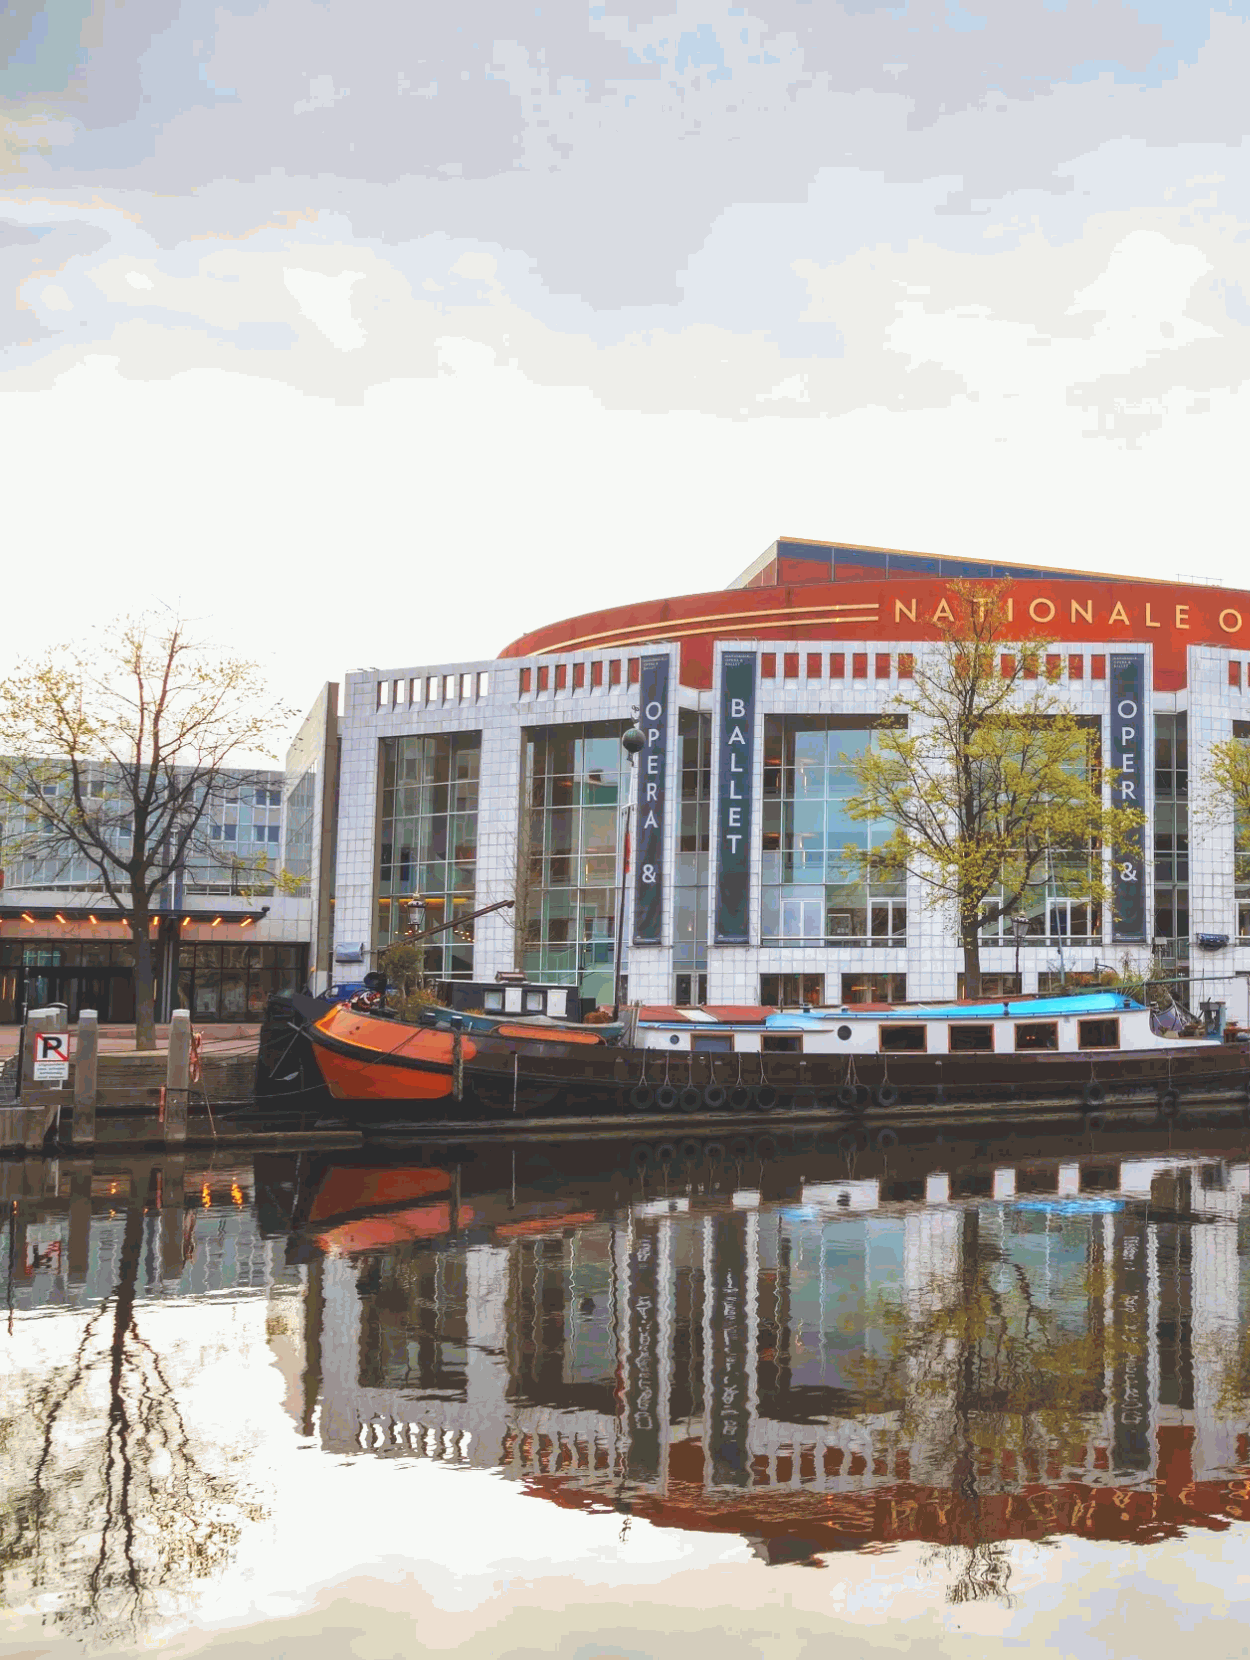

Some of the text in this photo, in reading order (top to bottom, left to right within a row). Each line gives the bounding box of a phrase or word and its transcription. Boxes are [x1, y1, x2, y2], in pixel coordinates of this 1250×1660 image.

[893, 597, 1191, 630] NATIONALE
[641, 701, 663, 883] OPERA &
[726, 699, 746, 854] BALLET
[1117, 700, 1138, 881] OPER &
[42, 1036, 62, 1058] P
